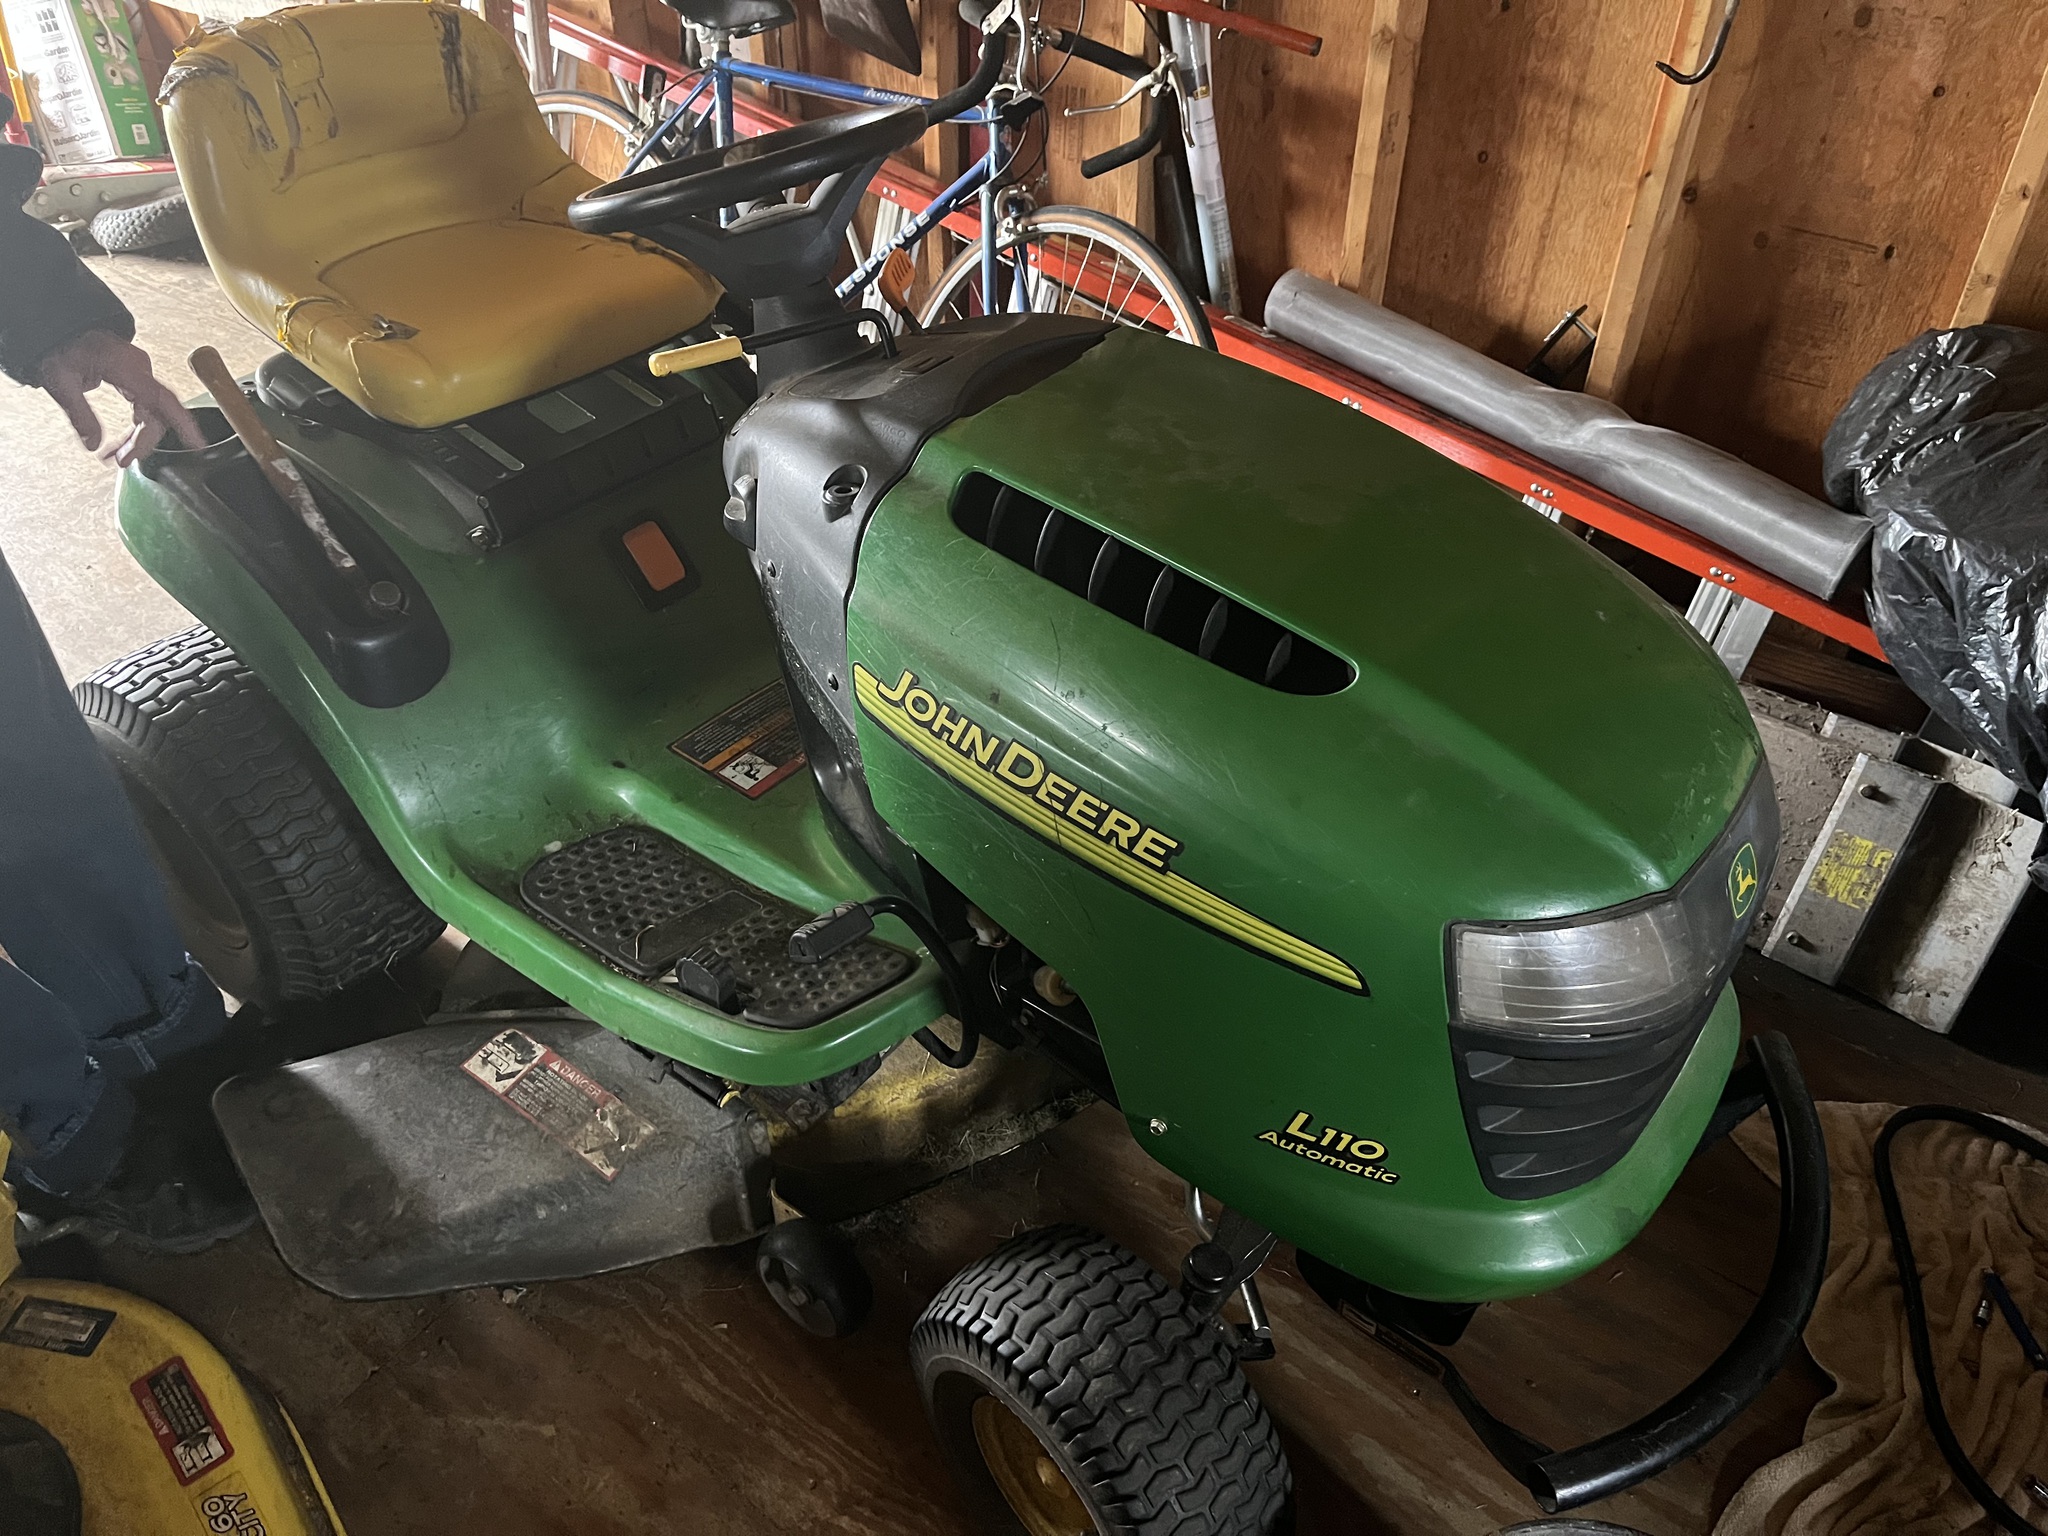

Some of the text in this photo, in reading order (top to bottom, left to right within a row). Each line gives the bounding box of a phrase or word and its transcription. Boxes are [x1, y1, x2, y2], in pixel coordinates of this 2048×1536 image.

[877, 669, 1000, 765] JOHN
[996, 741, 1178, 868] DEERE
[560, 1064, 602, 1098] DANGER
[1258, 1131, 1397, 1183] Automatic
[1285, 1111, 1385, 1160] L110
[202, 1496, 234, 1533] 60
